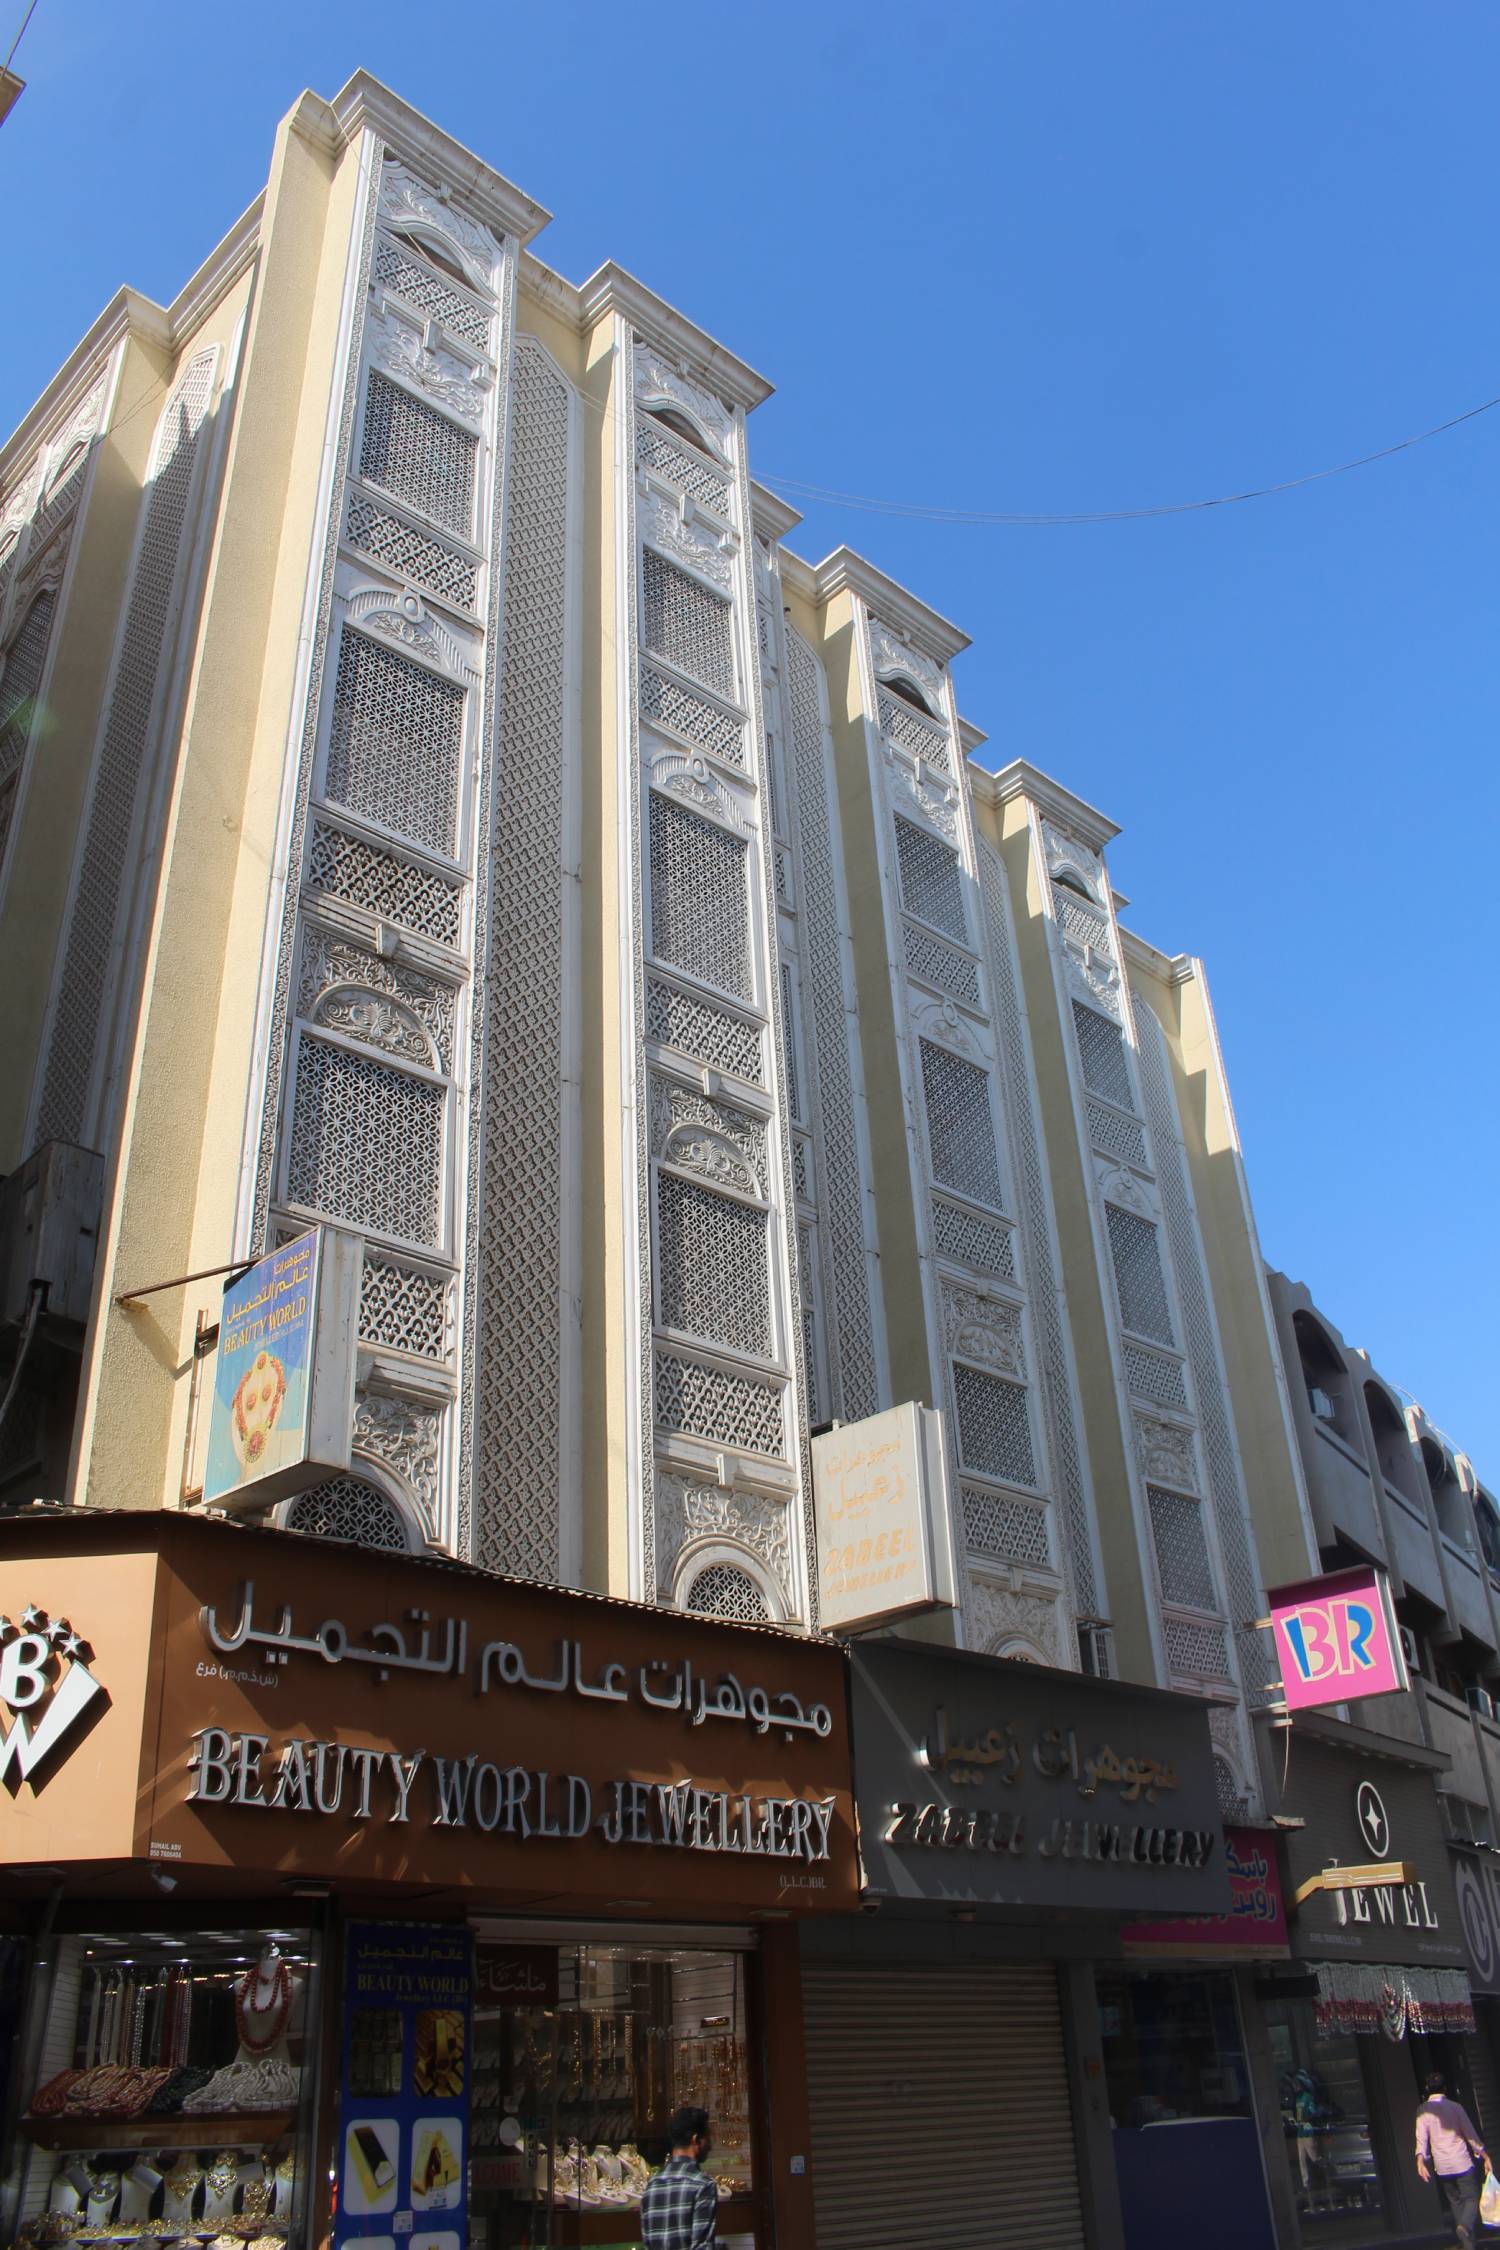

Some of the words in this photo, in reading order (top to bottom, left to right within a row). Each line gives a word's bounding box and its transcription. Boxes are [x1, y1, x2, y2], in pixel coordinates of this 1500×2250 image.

[274, 1247, 311, 1278] مجوهرات
[275, 1265, 309, 1299] عالم
[224, 1315, 267, 1355] BEAUTY
[268, 1296, 306, 1331] WORLD
[227, 1279, 275, 1324] التجميل
[824, 1522, 914, 1577] ZABEEL
[200, 1580, 467, 1683] التجميل
[1280, 1599, 1376, 1683] BR
[195, 1661, 217, 1677] فرع
[481, 1639, 628, 1701] عالم
[640, 1659, 832, 1742] مجوهرات
[914, 1705, 1021, 1785] زعبيل
[1033, 1726, 1180, 1802] مجوهرات
[186, 1726, 427, 1823] BEAUTY
[433, 1752, 592, 1839] WORLD
[601, 1778, 836, 1866] JEWELLERY
[884, 1802, 1025, 1853] ZABEEL
[1328, 1858, 1439, 1928] JEWEL
[357, 1974, 413, 1992] BEAUTY
[417, 1975, 470, 1994] WORLD
